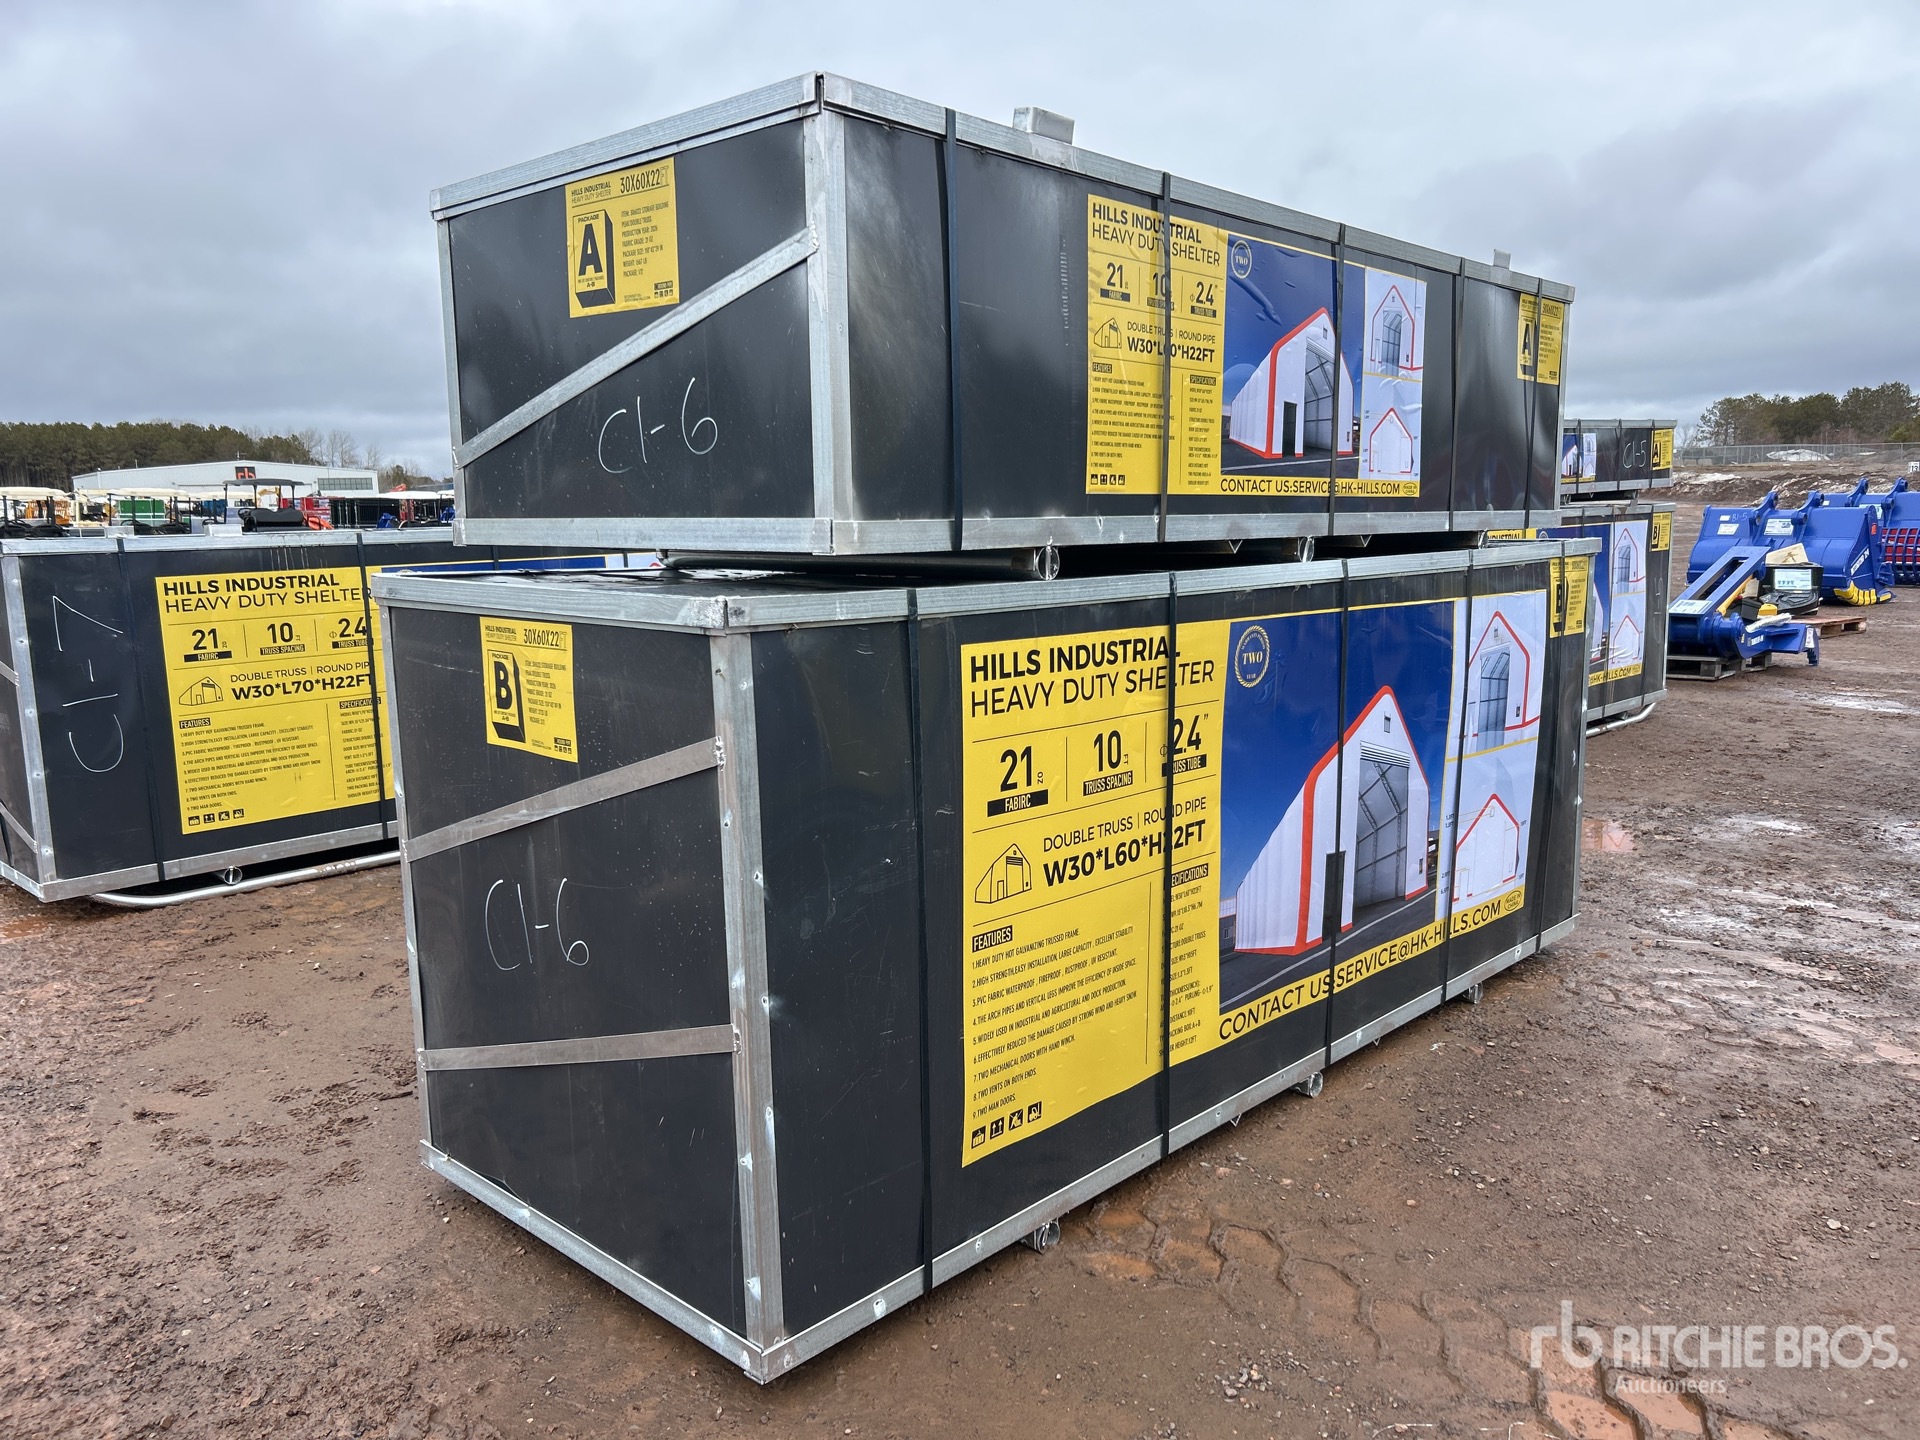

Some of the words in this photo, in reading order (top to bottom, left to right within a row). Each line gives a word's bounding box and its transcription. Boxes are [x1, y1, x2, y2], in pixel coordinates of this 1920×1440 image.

[578, 214, 600, 223] PACKAGE
[1093, 203, 1128, 225] HILLS
[578, 223, 603, 276] A
[1093, 223, 1134, 246] HEAVY
[1172, 242, 1220, 266] SHELTER
[1235, 256, 1248, 266] TWO
[1106, 262, 1123, 289] 21
[1128, 321, 1153, 334] DOUBLE
[1154, 326, 1173, 337] TRUS
[1179, 330, 1201, 341] ROUND
[1203, 334, 1216, 344] PIPE
[1522, 324, 1531, 356] A
[1128, 336, 1215, 363] W30L0H22FT
[1093, 363, 1112, 373] FEATURES
[598, 377, 718, 474] C1-6
[1623, 440, 1647, 468] C1-5
[1221, 479, 1272, 493] CONTACT
[164, 580, 219, 596] HILLS
[226, 574, 339, 593] INDUSTRIAL
[166, 596, 231, 613] HEAVY
[239, 593, 288, 608] DUTY
[192, 628, 218, 651] 21
[267, 622, 293, 644] 10
[338, 640, 354, 648] TRUSS
[492, 652, 509, 660] PACKAGE
[970, 649, 1040, 682] HILLS
[1242, 651, 1263, 665] TWO
[53, 595, 124, 773] C1-7
[230, 672, 272, 682] DOUBLE
[275, 668, 306, 678] TRUSS
[316, 664, 352, 674] ROUND
[355, 661, 370, 670] PIP
[494, 661, 512, 709] B
[971, 680, 1054, 717] HEAVY
[1063, 671, 1119, 704] DUTY
[1125, 659, 1214, 694] SHETER
[180, 719, 210, 728] FEATURES
[1093, 728, 1122, 773] 10
[1186, 755, 1201, 771] TUBE
[1000, 744, 1032, 792] 21
[1085, 776, 1105, 795] TRUSS
[1106, 770, 1131, 790] SPACING
[1004, 793, 1030, 812] FABIRC
[1043, 826, 1094, 852] DOUBLE
[1097, 816, 1133, 839] TRUSS
[1186, 796, 1206, 811] PIPE
[1172, 865, 1207, 886] ECIFICATIONS
[1506, 895, 1515, 904] MADE
[1508, 900, 1519, 909] CHINA
[484, 878, 589, 971] C1-6
[974, 927, 1011, 951] FEATURES
[992, 951, 1004, 963] DUTY
[1005, 948, 1014, 959] HOT
[1016, 938, 1044, 955] GALVANIZING
[1045, 932, 1064, 945] TRUSSED
[1058, 946, 1071, 959] LARGE
[1073, 940, 1091, 954] CAPACITY
[1095, 932, 1114, 946] EXCELLENT
[1115, 926, 1132, 939] STABILITY
[988, 988, 1004, 1002] FABRIC
[1006, 977, 1034, 995] WATERPROOF
[1039, 968, 1060, 983] FIREPROOF
[988, 1008, 1000, 1021] ARCH
[1001, 1003, 1014, 1016] PIPES
[1015, 999, 1024, 1010] AND
[1026, 991, 1046, 1007] VERTICAL
[995, 1024, 1007, 1036] USED
[1009, 1022, 1013, 1031] IN
[1015, 1011, 1040, 1029] INDUSTRIAL
[1042, 1008, 1050, 1018] AND
[1082, 992, 1090, 1003] AND
[1091, 988, 1101, 999] DOCK
[1220, 984, 1304, 1040] CONTACT
[1007, 1035, 1026, 1051] REDUCED
[1037, 1024, 1054, 1039] DAMAGE
[1055, 1016, 1071, 1031] CAUSED
[1072, 1014, 1077, 1024] BY
[1078, 1007, 1094, 1021] STRONG
[990, 1057, 1018, 1076] MECHANICAL
[1020, 1050, 1035, 1063] DOORS
[1036, 1045, 1047, 1056] WITH
[1048, 1040, 1060, 1051] HAND
[989, 1081, 1002, 1094] VENTS
[1004, 1078, 1010, 1088] ON
[1011, 1072, 1023, 1085] BOTH
[988, 1100, 998, 1112] MAN
